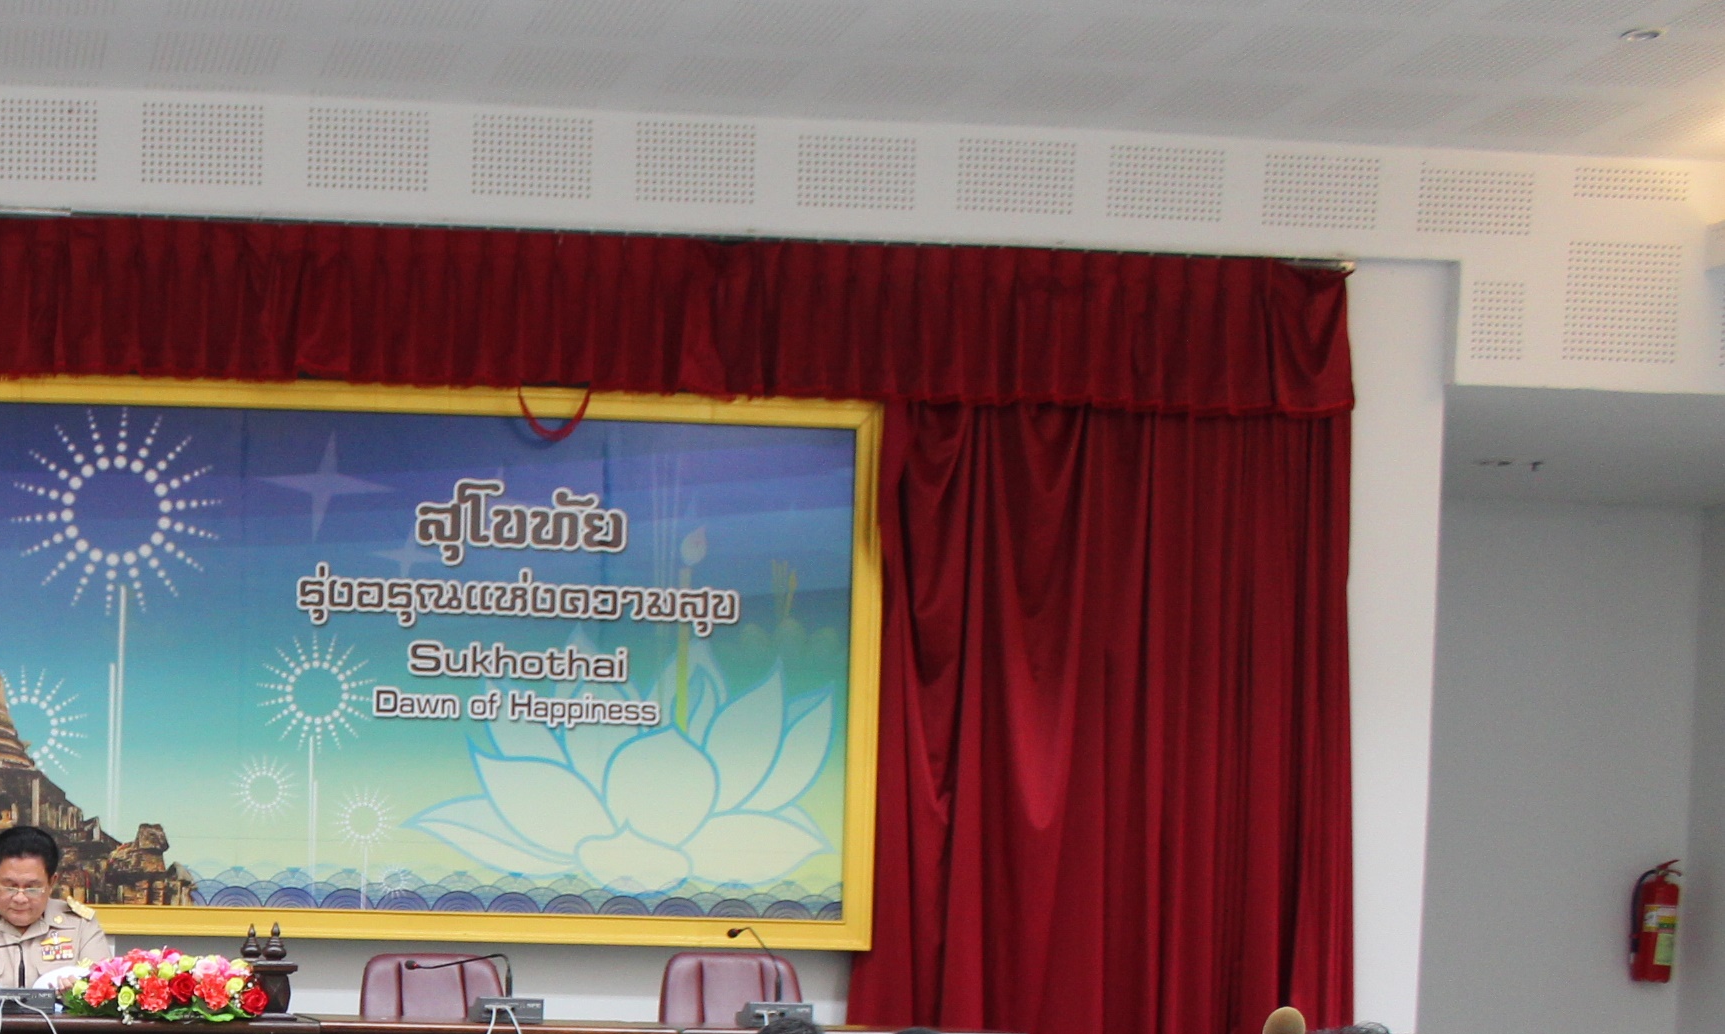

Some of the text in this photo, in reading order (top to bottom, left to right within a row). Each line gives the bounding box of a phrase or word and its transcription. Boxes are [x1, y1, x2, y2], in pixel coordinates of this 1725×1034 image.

[416, 478, 627, 566] สุโขทัย
[296, 562, 741, 636] รุ่งอรุณแห่งความสุข
[407, 640, 629, 683] Sukhothai
[373, 687, 662, 728] Dawn of Happiness
